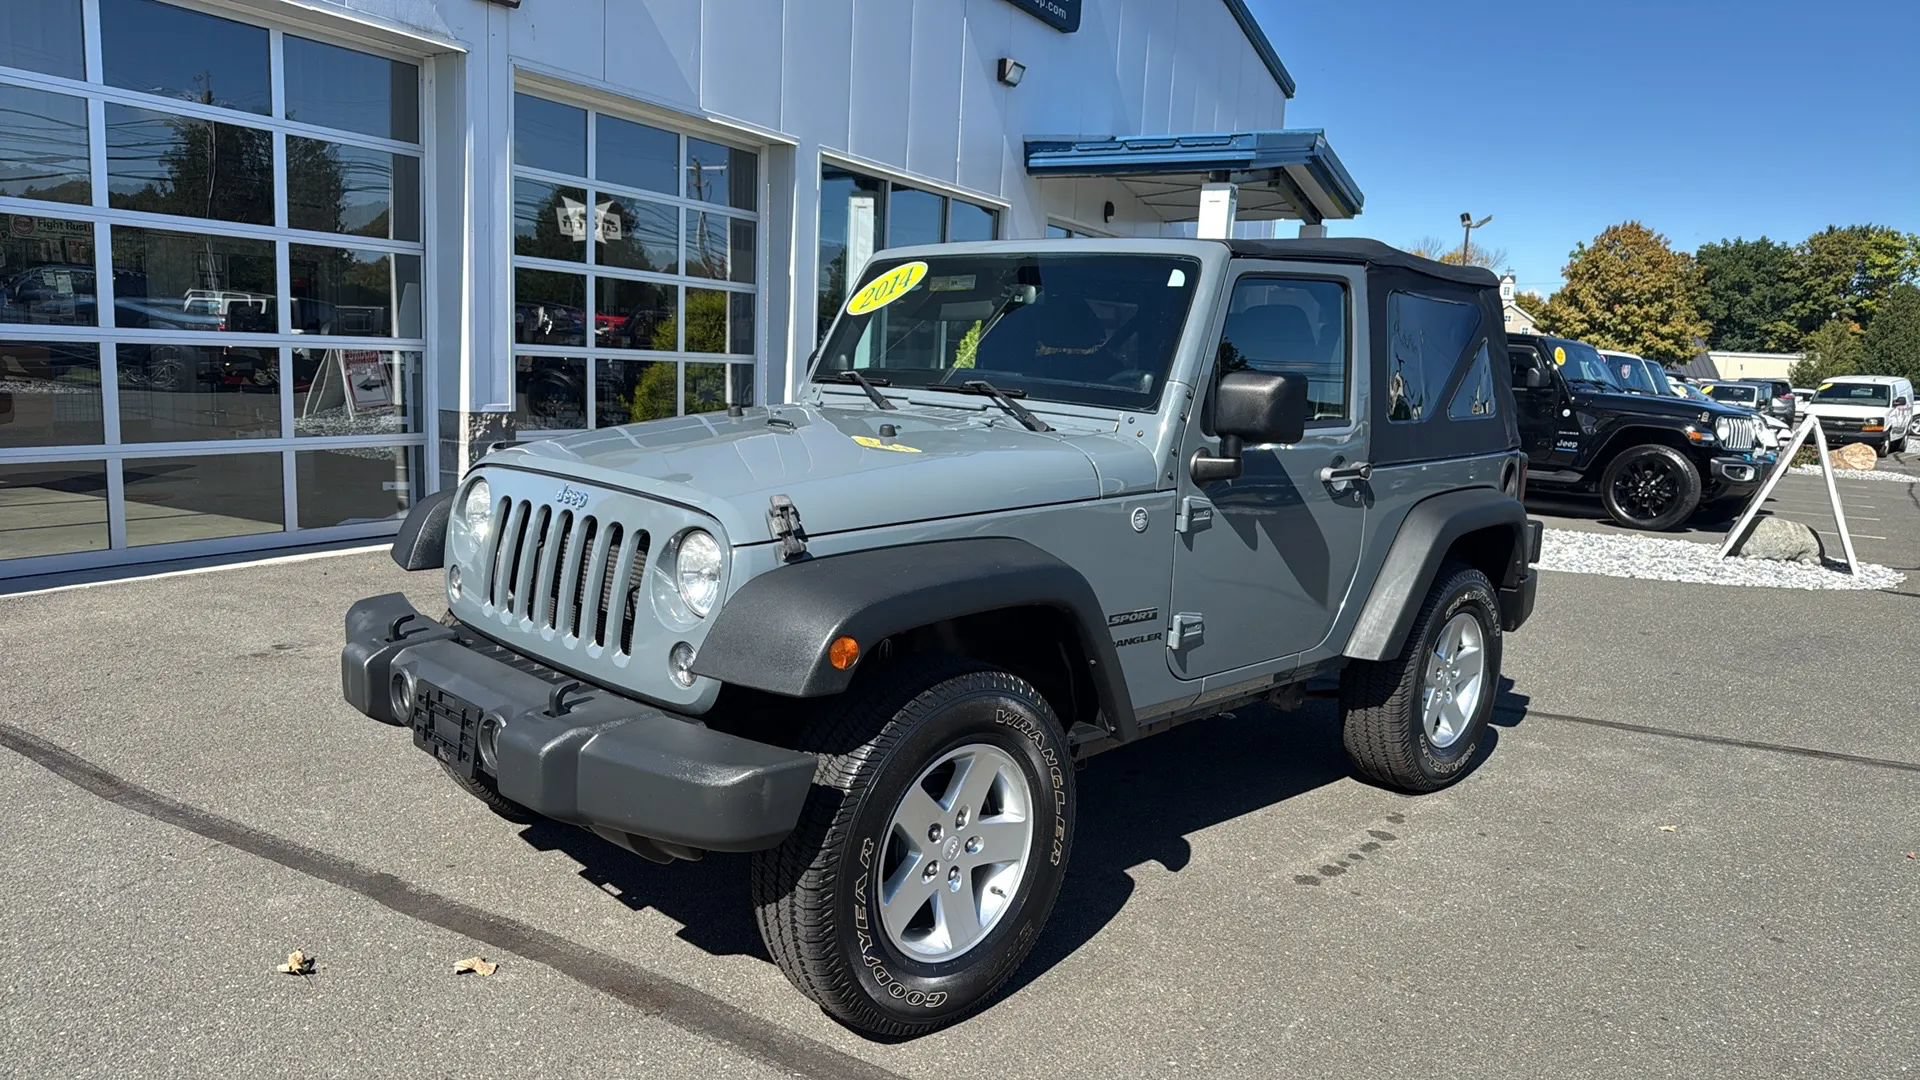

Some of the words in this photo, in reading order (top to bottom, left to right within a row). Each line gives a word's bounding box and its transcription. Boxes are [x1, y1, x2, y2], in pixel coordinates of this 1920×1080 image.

[859, 266, 915, 310] 2014
[1556, 439, 1578, 449] Jeep
[556, 484, 588, 510] Jeep
[1110, 611, 1155, 625] SPORT
[1112, 632, 1162, 648] ANGLER
[996, 709, 1065, 867] WRANGLER
[854, 837, 948, 1008] GOODYEAR
